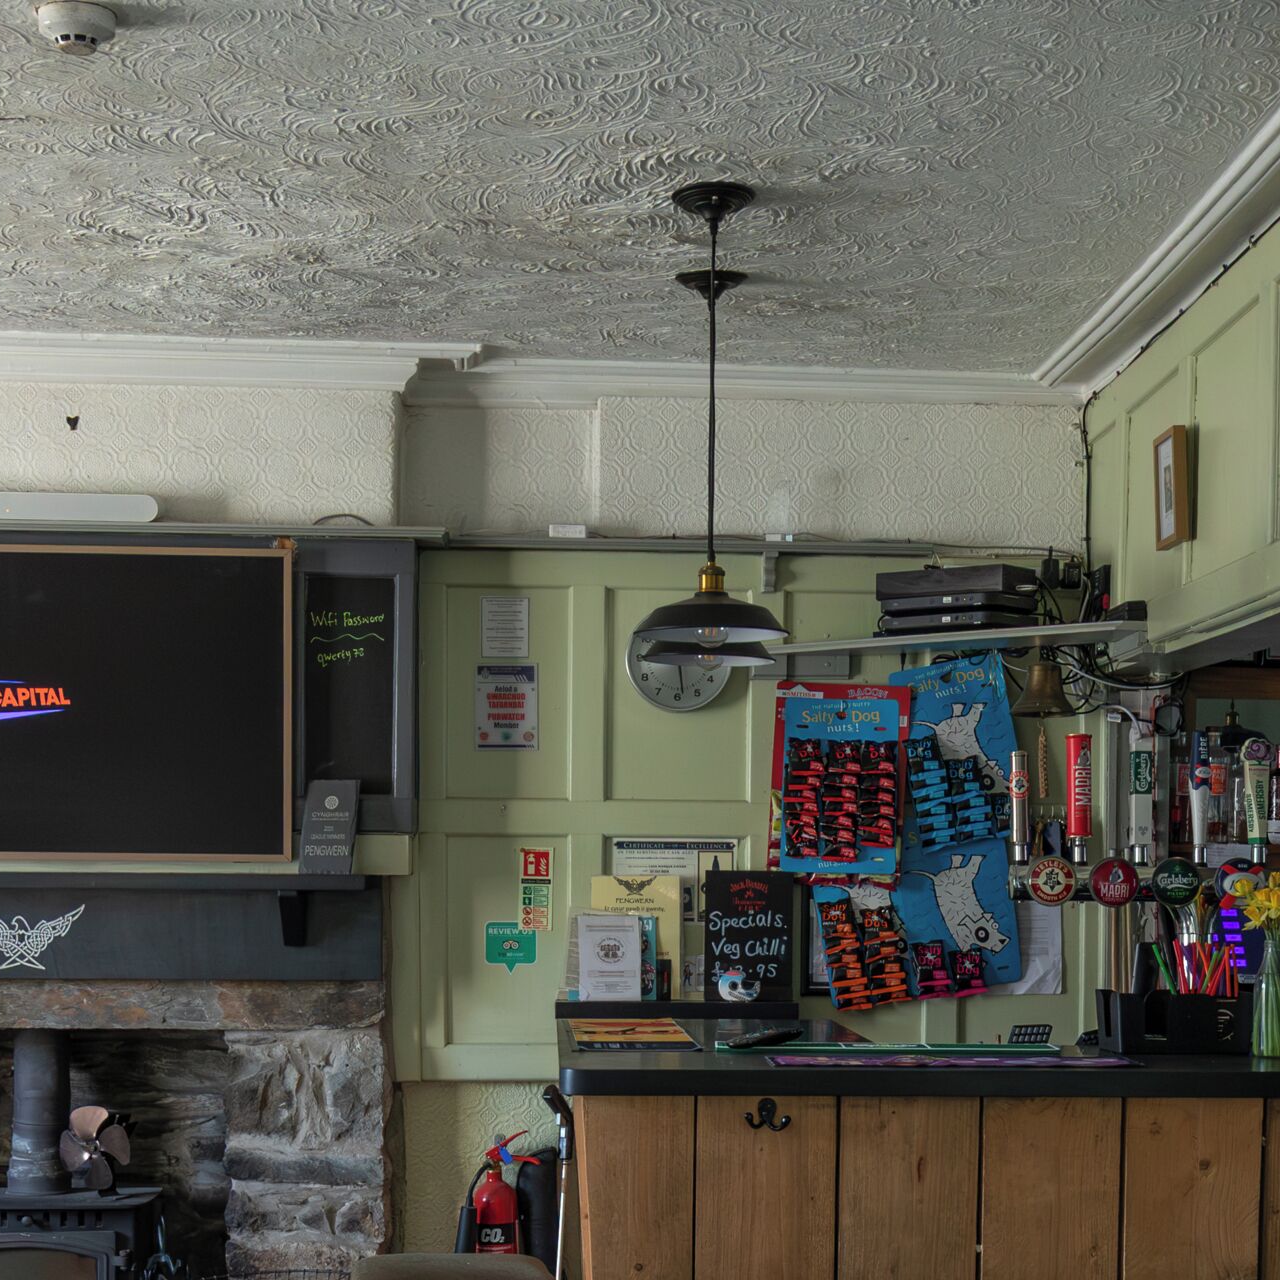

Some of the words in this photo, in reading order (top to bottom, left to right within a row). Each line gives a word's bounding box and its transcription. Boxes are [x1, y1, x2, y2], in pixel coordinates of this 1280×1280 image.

[641, 673, 649, 681] 8
[707, 675, 714, 683] 4
[955, 667, 986, 685] Dog
[655, 688, 662, 696] 7
[694, 689, 701, 697] 5
[934, 684, 968, 699] nuts!
[674, 693, 681, 702] 6
[802, 710, 836, 725] Salty
[851, 710, 880, 723] Dog
[827, 723, 859, 733] nuts!
[908, 748, 933, 759] Dog
[1135, 753, 1149, 792] Carlsberg
[1256, 780, 1266, 820] SOMERSBY
[304, 845, 350, 857] PENGWERN
[1157, 872, 1199, 889] Carlsberg
[823, 912, 847, 921] Dog
[488, 927, 520, 935] REVIEW
[711, 937, 741, 960] Veg
[745, 936, 788, 956] Chilli
